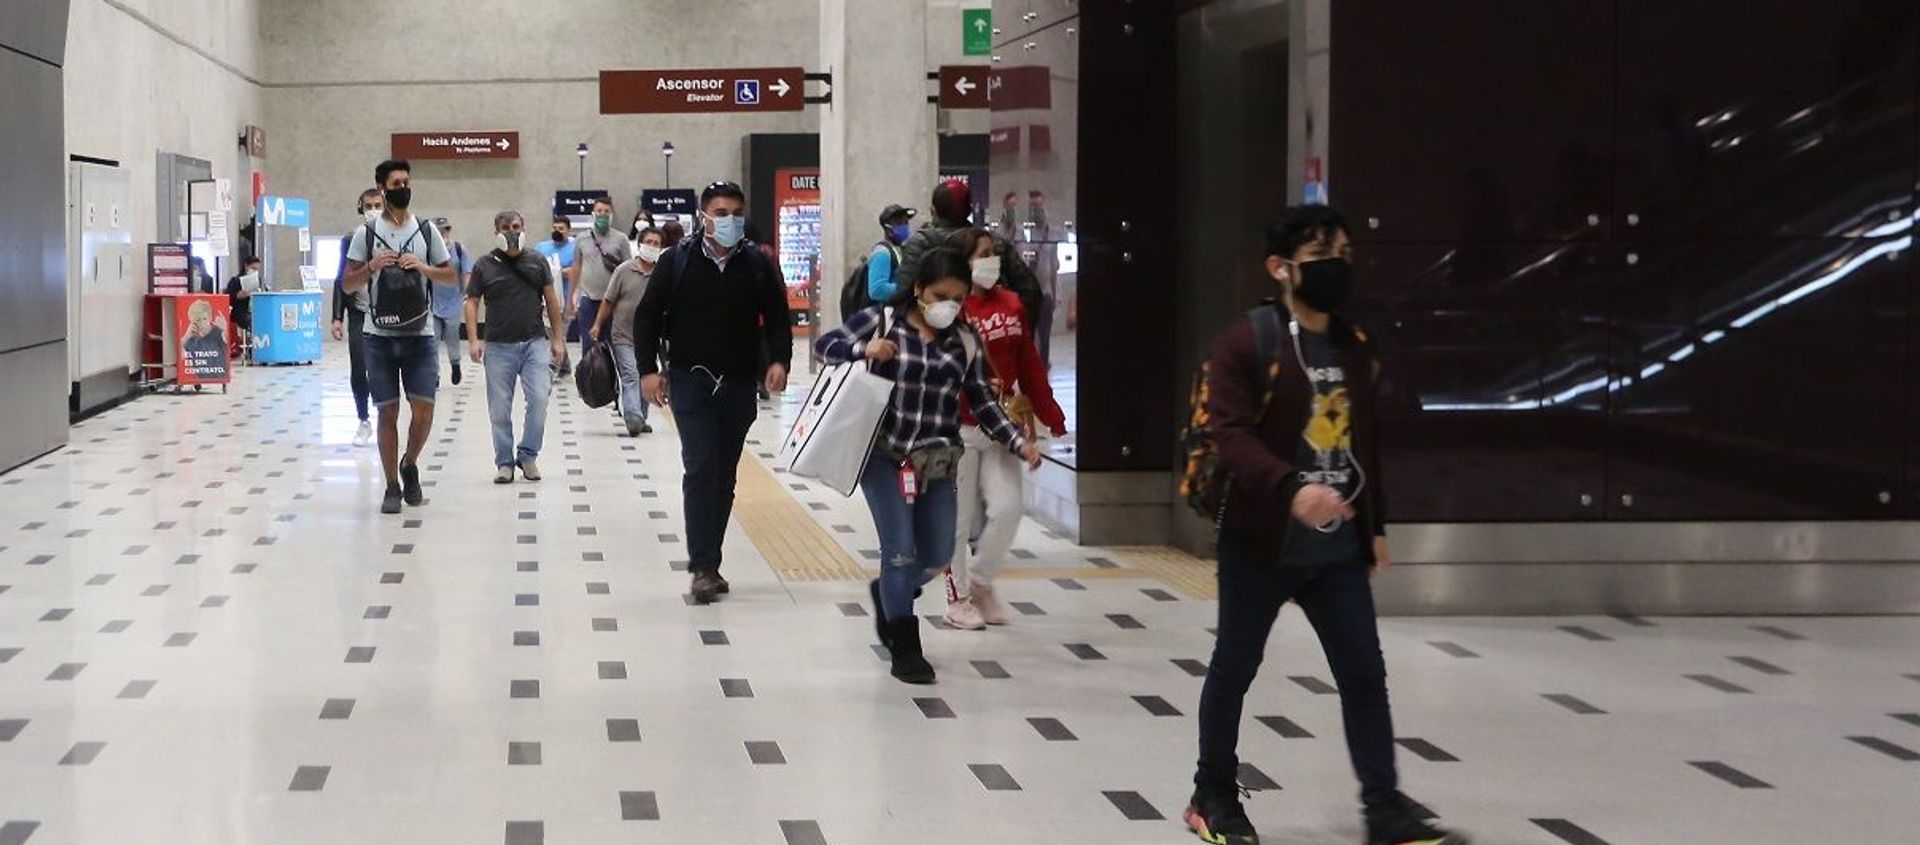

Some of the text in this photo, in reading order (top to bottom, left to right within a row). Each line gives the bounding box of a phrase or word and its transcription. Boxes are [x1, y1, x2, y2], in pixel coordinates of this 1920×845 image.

[656, 77, 725, 90] Ascensor
[686, 93, 724, 102] Elevator
[422, 136, 491, 146] Hacia Andenes
[184, 351, 193, 359] EL
